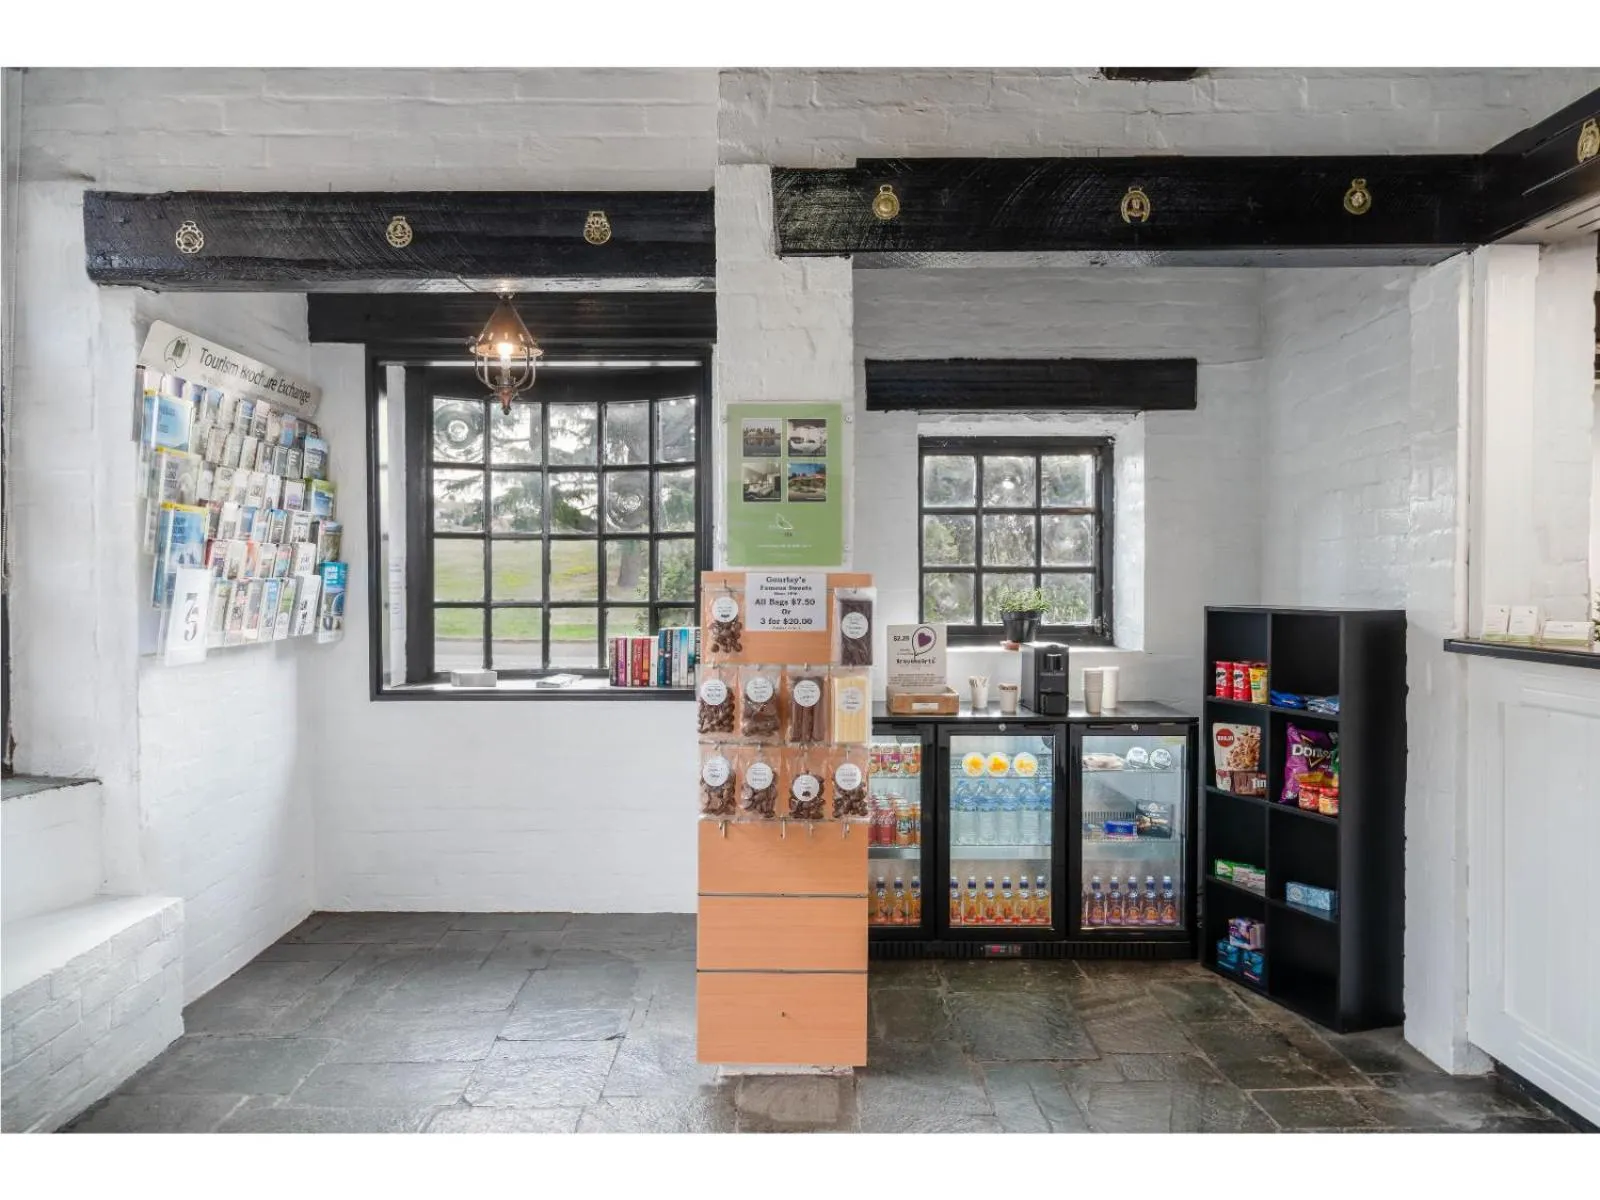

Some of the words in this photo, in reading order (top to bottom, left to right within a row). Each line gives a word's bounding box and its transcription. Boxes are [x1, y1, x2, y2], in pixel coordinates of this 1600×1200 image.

[200, 346, 240, 377] Tourism
[276, 376, 312, 405] Exchange
[769, 598, 788, 606] Bags
[791, 598, 816, 606] $7.50
[760, 617, 766, 625] 3
[768, 617, 780, 625] for
[783, 617, 813, 625] $20.00
